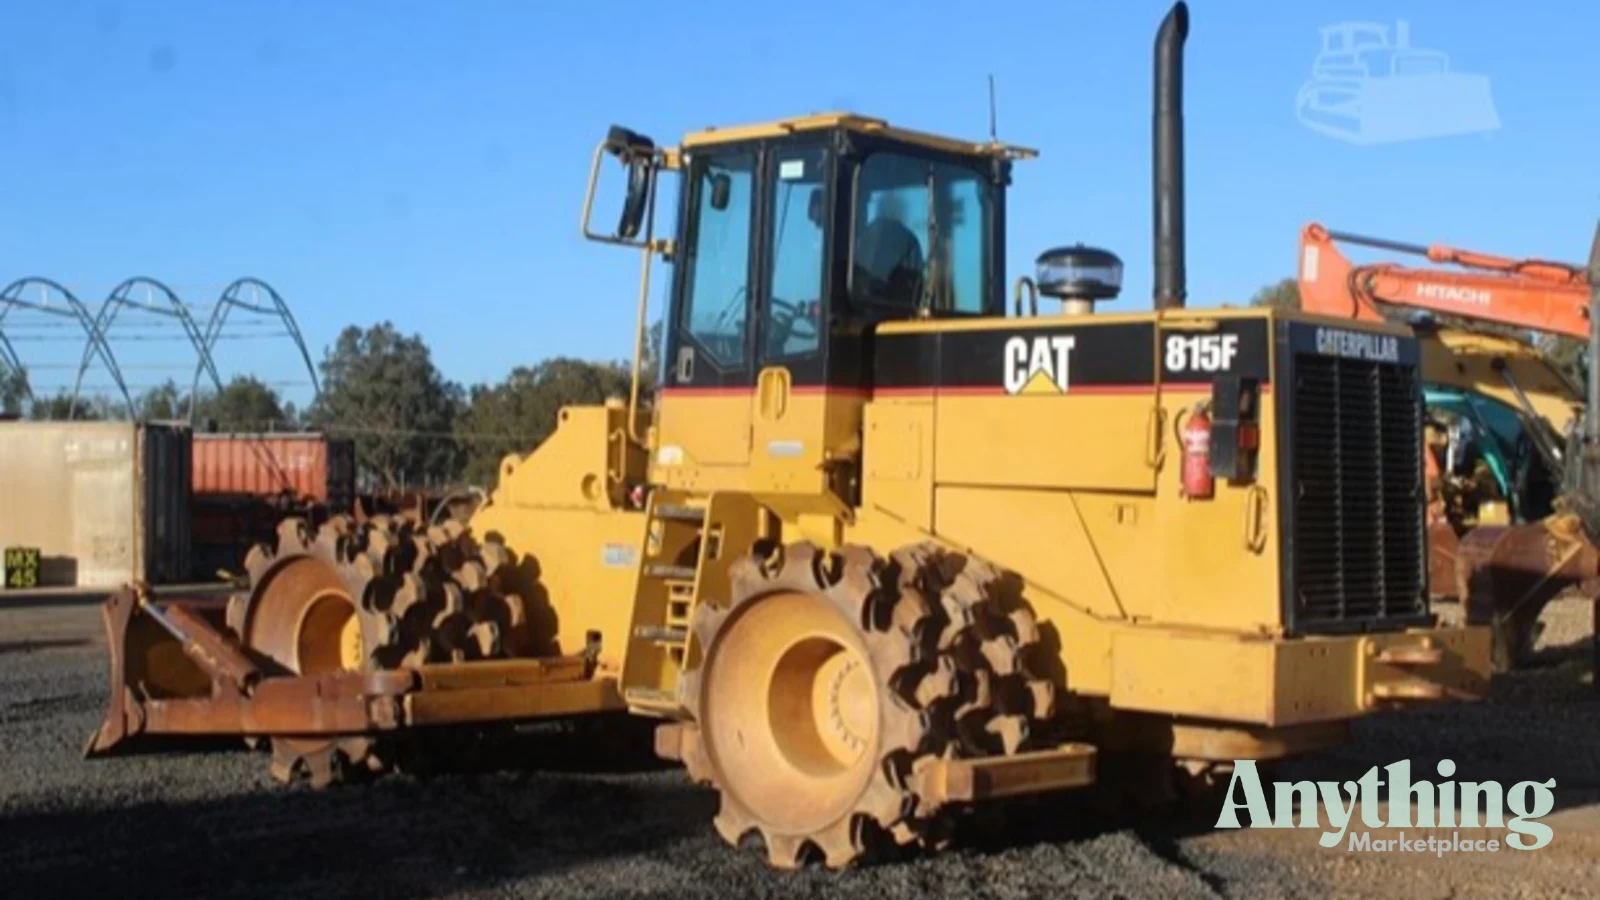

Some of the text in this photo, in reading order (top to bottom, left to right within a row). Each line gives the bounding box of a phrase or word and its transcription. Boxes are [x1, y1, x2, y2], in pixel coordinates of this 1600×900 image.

[1416, 283, 1492, 305] HITACHI
[1165, 334, 1239, 372] 815F
[1315, 327, 1399, 362] CATERPILLAR
[1004, 335, 1076, 395] CAT
[7, 550, 38, 567] MX
